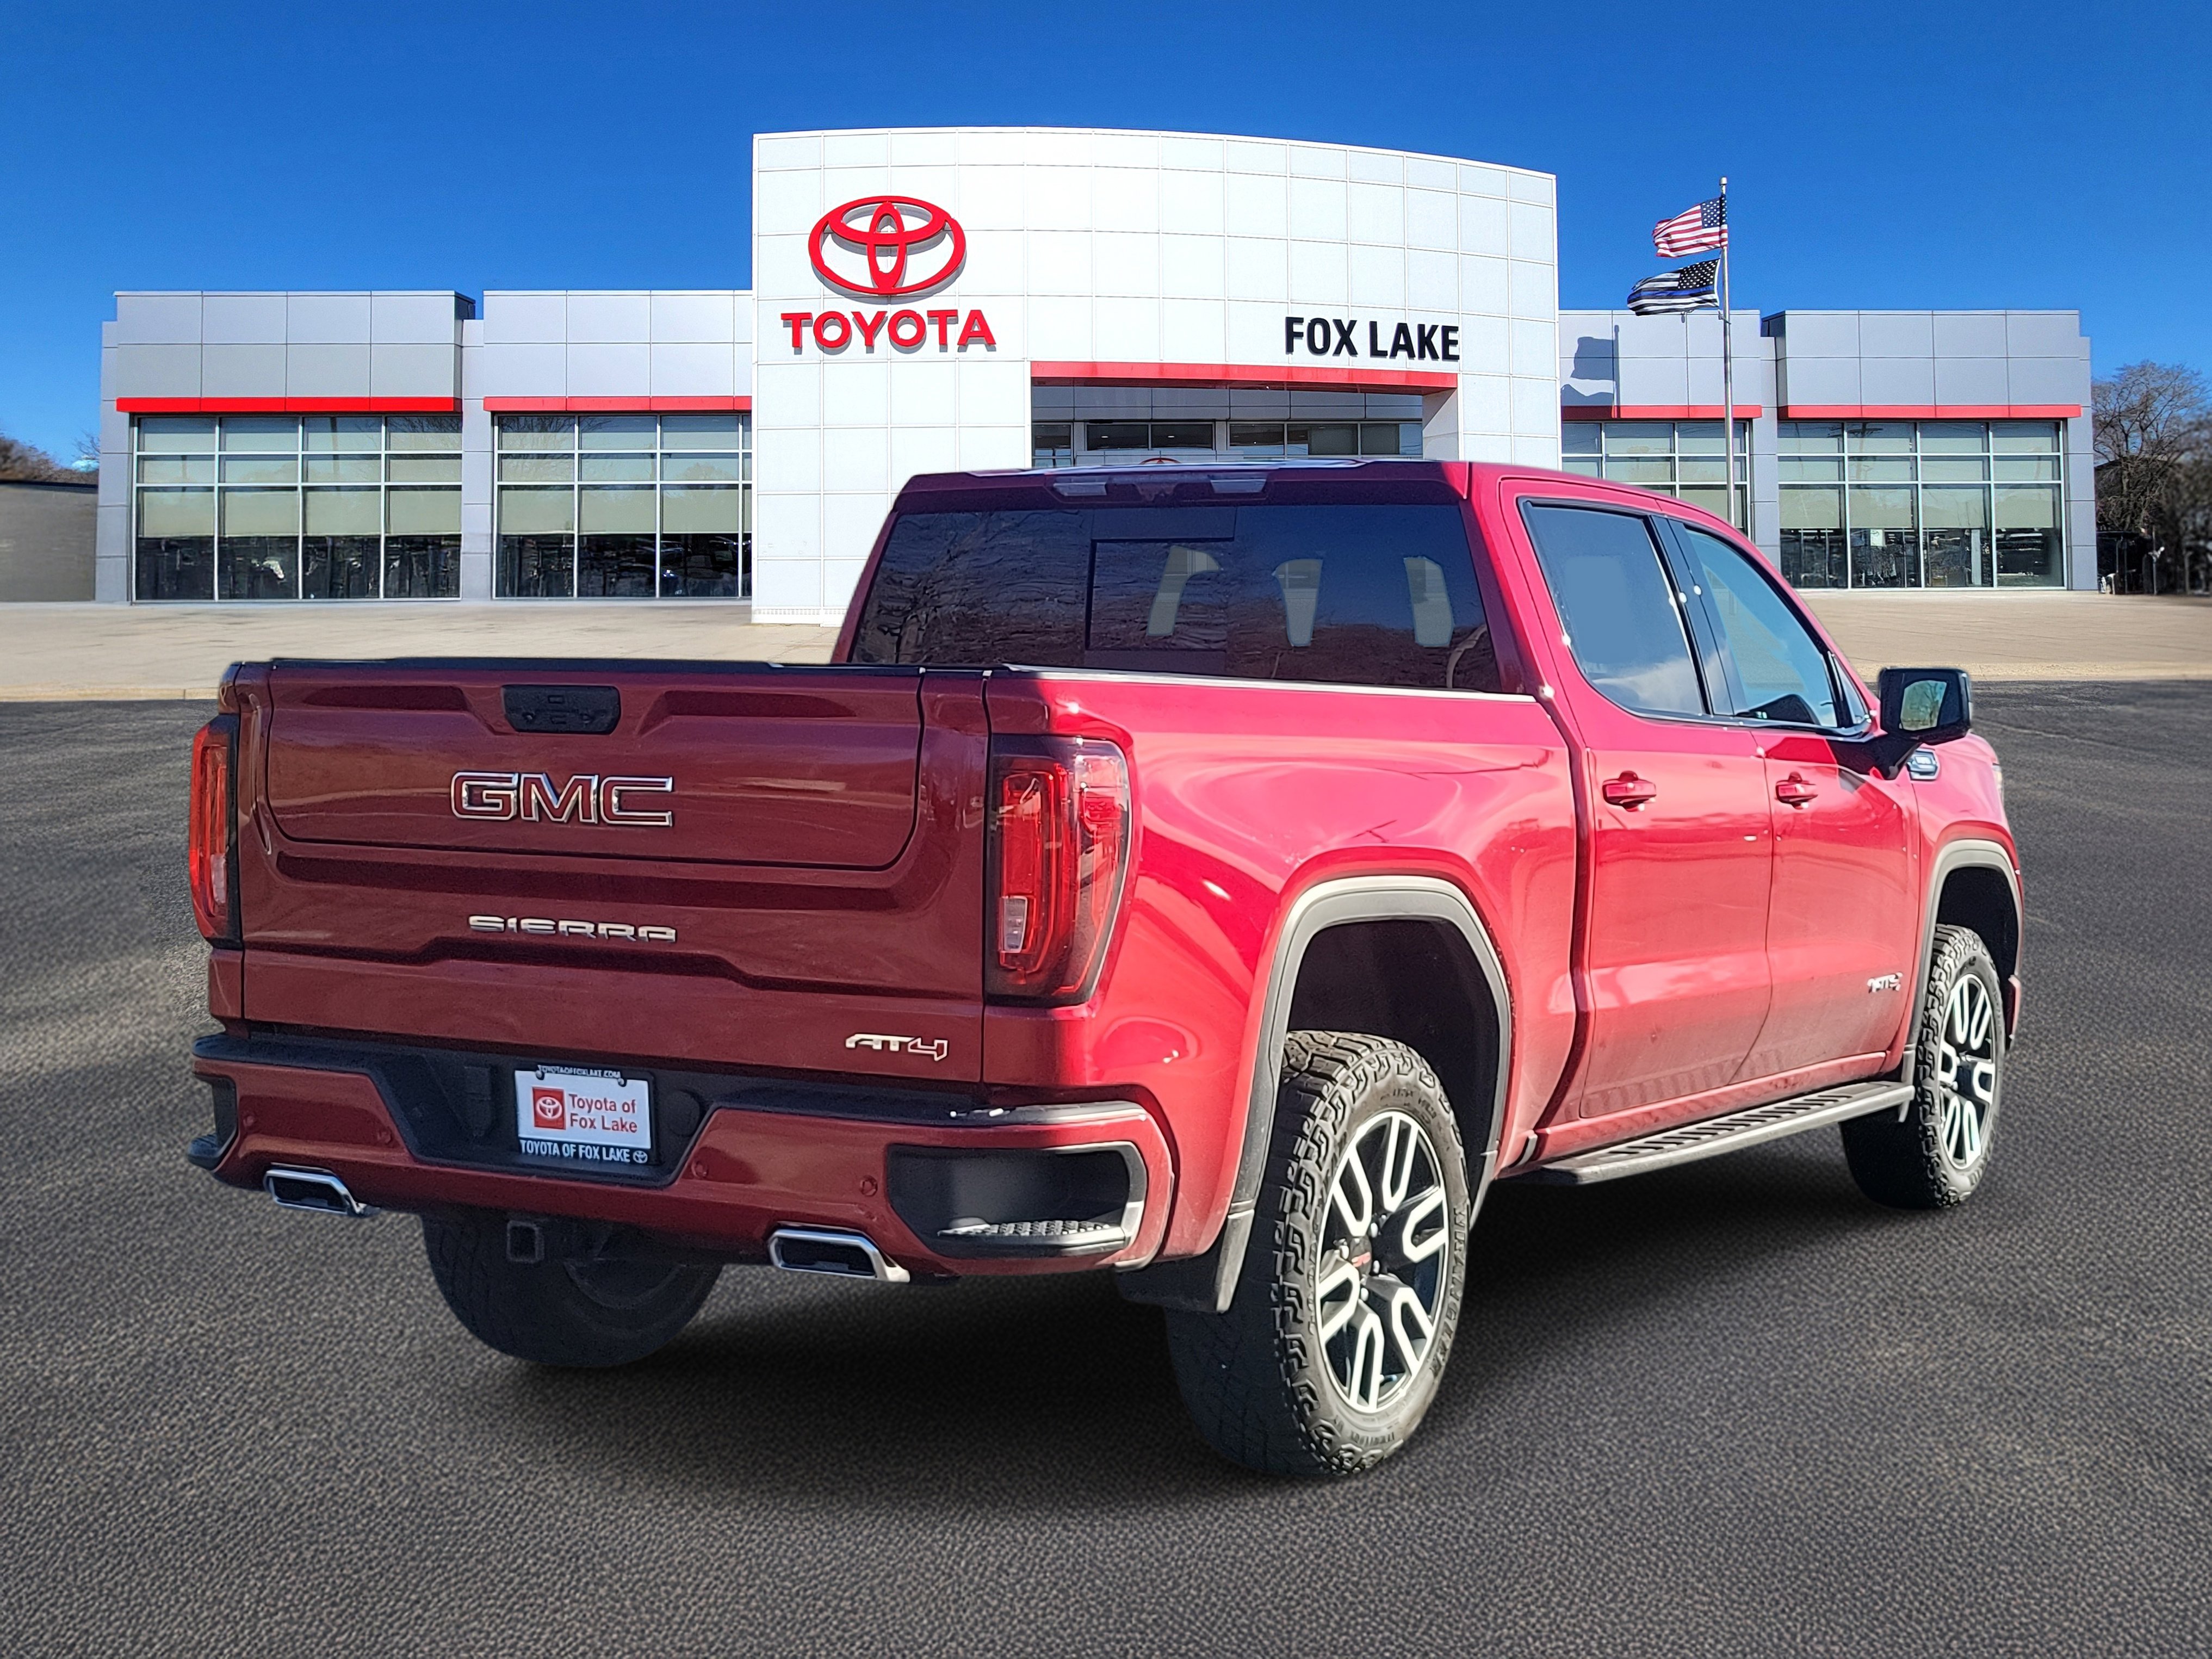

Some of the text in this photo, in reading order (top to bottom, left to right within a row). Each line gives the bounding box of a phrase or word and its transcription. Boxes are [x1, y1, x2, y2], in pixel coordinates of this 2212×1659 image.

[780, 309, 997, 351] TOYOTA
[1285, 316, 1460, 360] FOX LAKE
[450, 771, 673, 827] GMC
[468, 915, 677, 943] SIERRA
[845, 1033, 949, 1061] AT4
[568, 1093, 637, 1113] Toyota of
[570, 1113, 637, 1133] Fox Lake
[520, 1140, 630, 1162] TOYOTA OF FOX LAKE
[1429, 1206, 1466, 1378] WRANGLER
